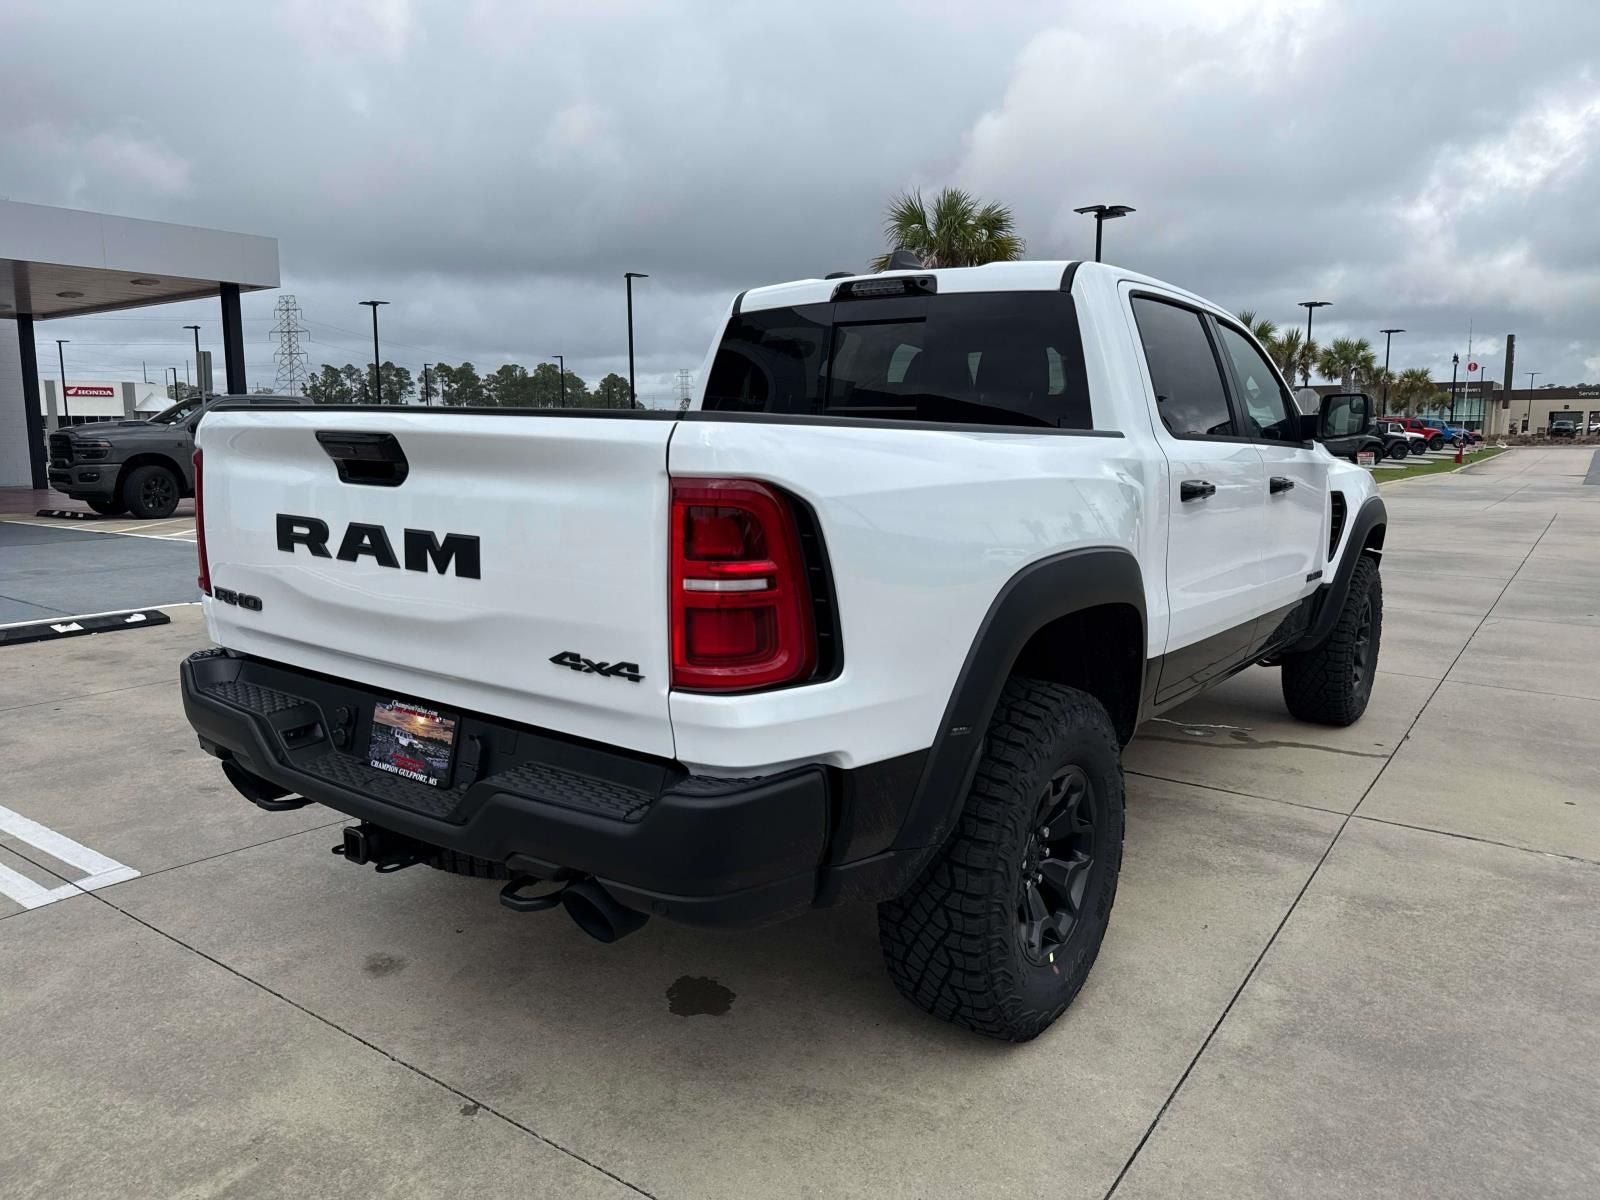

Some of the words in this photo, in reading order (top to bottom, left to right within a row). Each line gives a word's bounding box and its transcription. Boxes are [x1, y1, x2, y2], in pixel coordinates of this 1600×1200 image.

[276, 513, 481, 580] RAM
[213, 585, 263, 611] RHO
[370, 760, 398, 775] CHAMPION
[428, 777, 438, 786] MS
